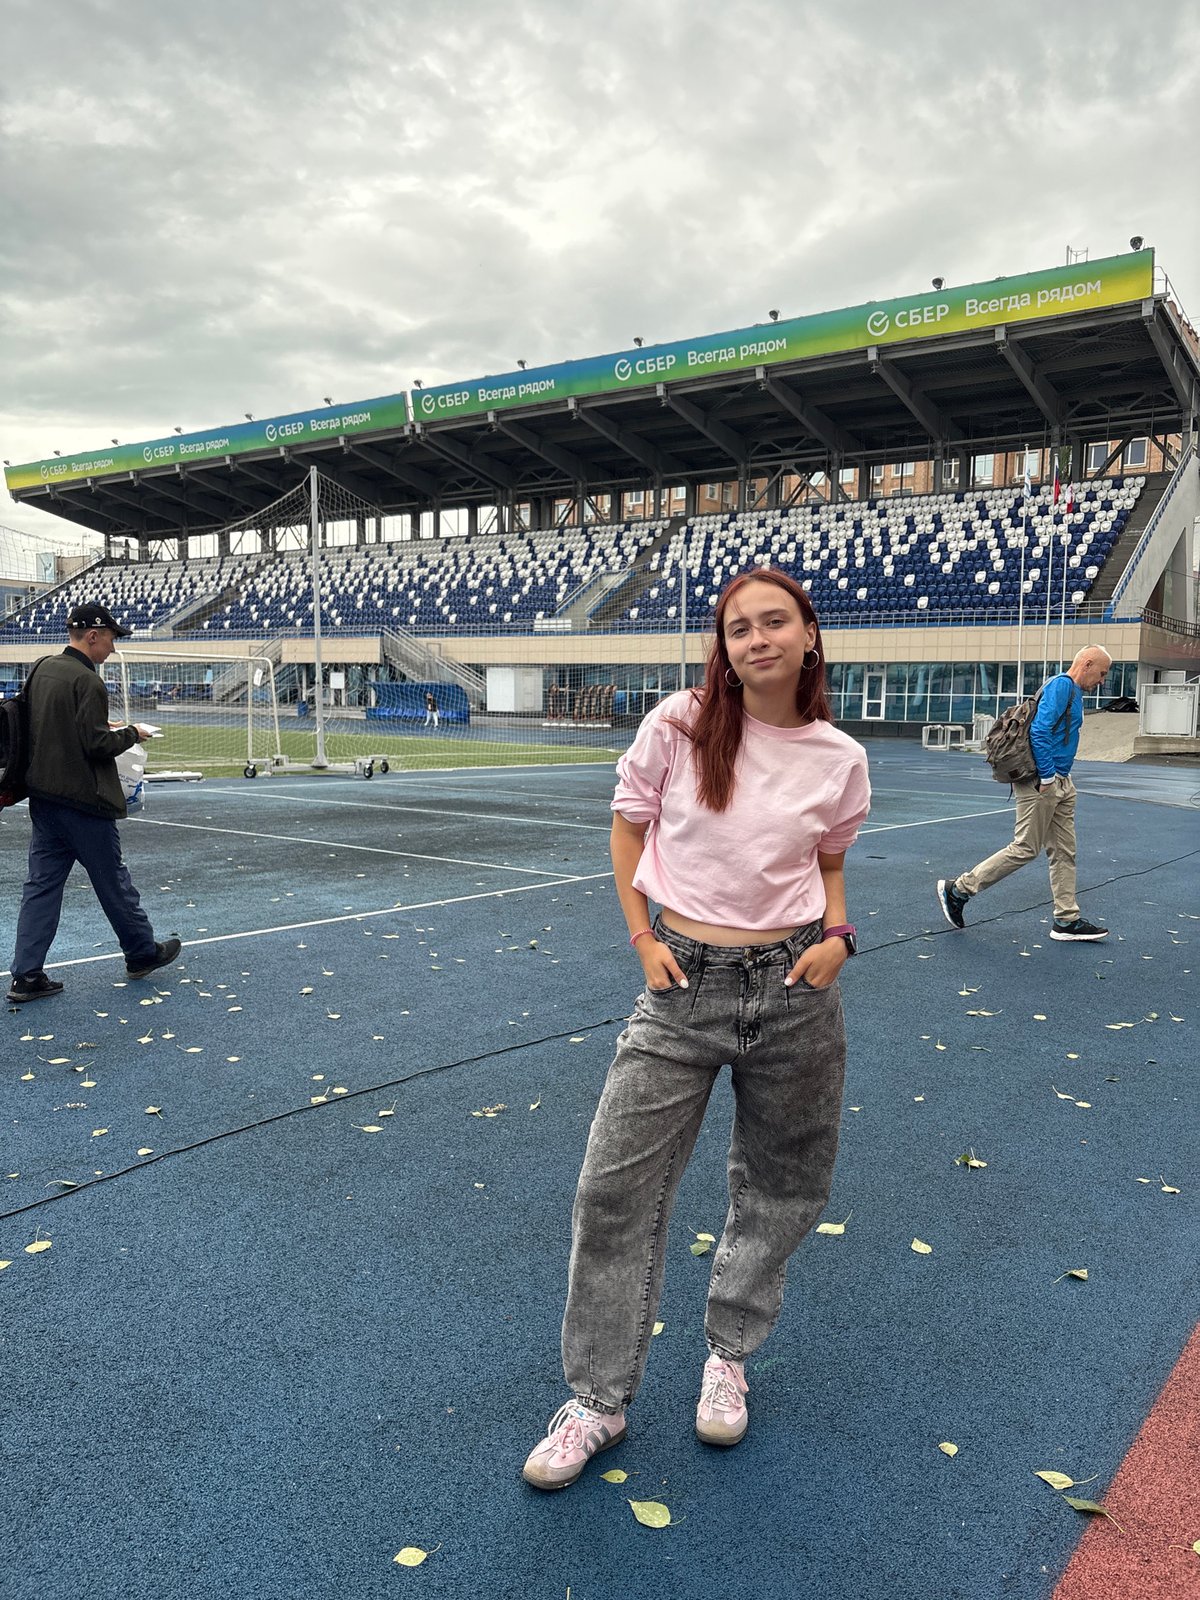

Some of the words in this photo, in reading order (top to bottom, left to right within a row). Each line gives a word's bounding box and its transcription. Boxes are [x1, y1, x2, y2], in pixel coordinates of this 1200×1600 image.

[895, 303, 949, 327] СБЕР
[965, 291, 1031, 317] Всегда
[1037, 279, 1102, 308] рядом
[635, 354, 676, 375] СБЕР
[687, 346, 737, 366] Всегда
[739, 337, 788, 360] рядом
[437, 391, 470, 409] СБЕР
[478, 384, 517, 403] Всегда
[518, 377, 555, 399] рядом
[278, 422, 304, 438] СБЕР
[310, 416, 340, 432] Всегда
[342, 411, 371, 429] рядом
[153, 445, 175, 459] СБЕР
[179, 441, 204, 455] Всегда
[205, 437, 230, 453] рядом
